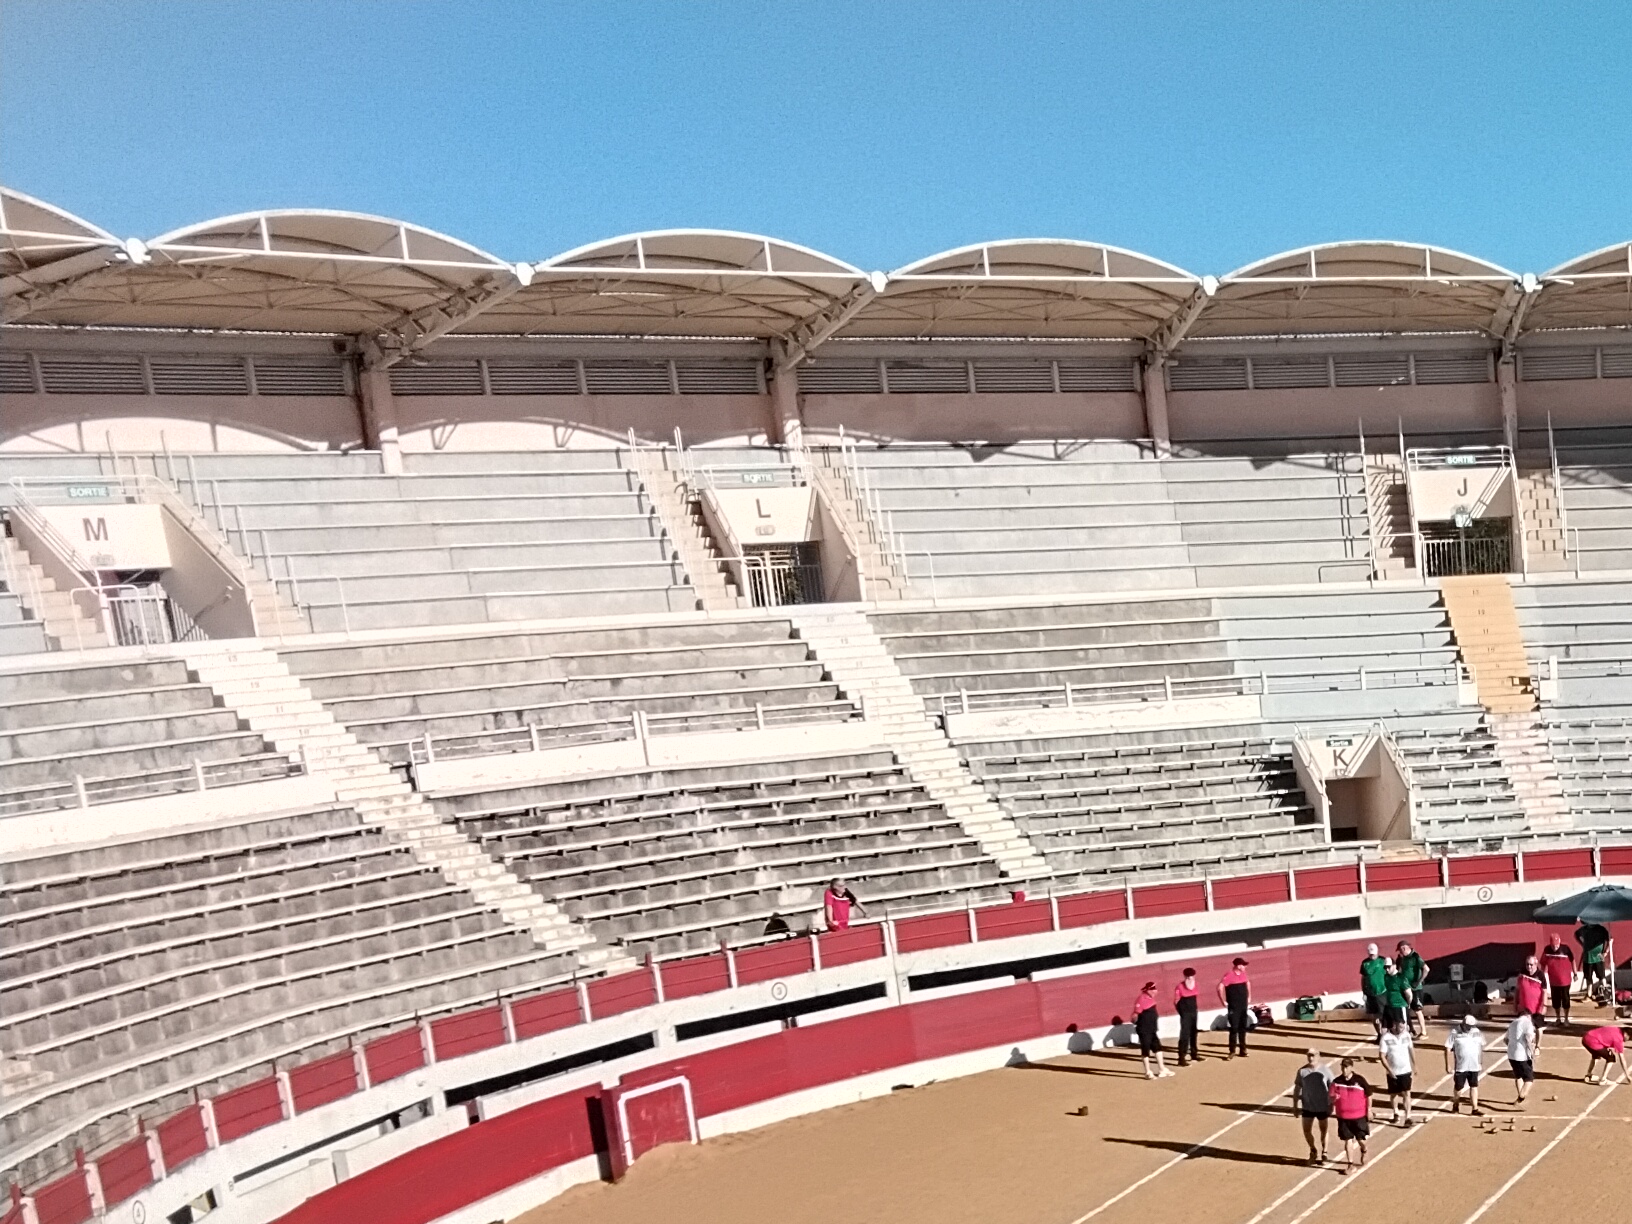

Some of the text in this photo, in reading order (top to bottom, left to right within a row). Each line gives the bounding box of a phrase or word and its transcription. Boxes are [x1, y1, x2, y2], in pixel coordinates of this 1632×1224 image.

[1447, 455, 1474, 464] SORTIE
[69, 487, 107, 497] SORTIE
[1457, 477, 1467, 497] J
[755, 498, 771, 518] L
[82, 517, 109, 541] M
[1333, 749, 1349, 767] K
